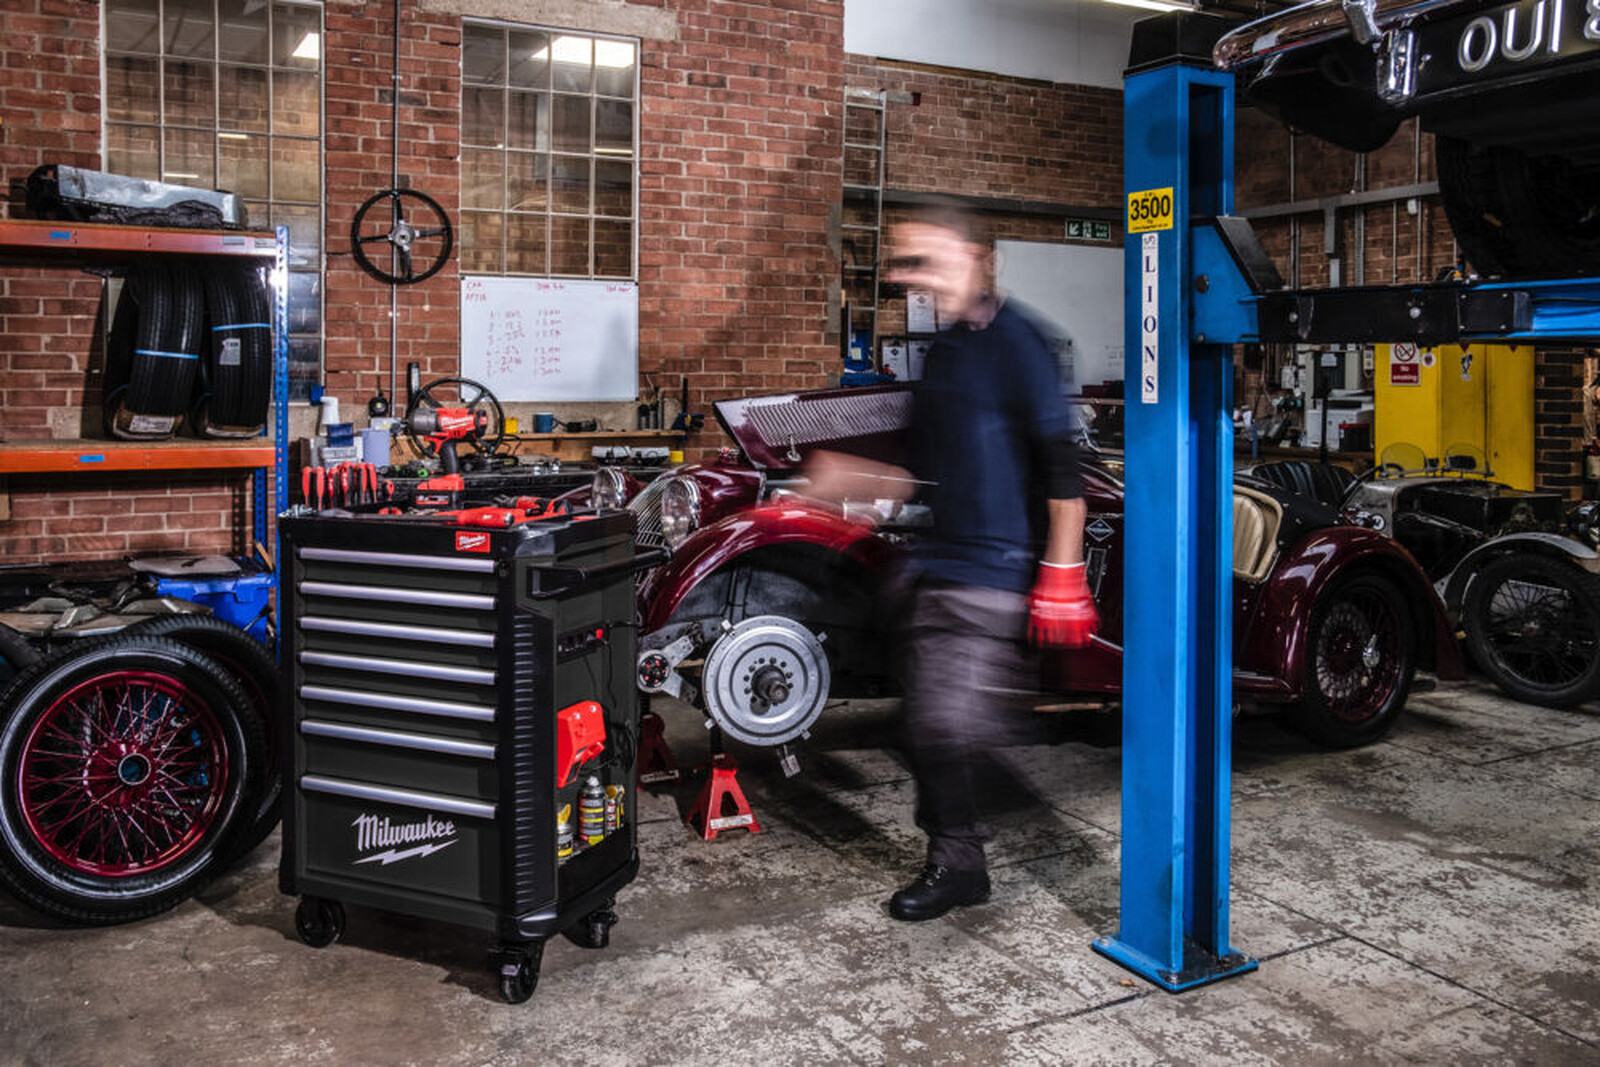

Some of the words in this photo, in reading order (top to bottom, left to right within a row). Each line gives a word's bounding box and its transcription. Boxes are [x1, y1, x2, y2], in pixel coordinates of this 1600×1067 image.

[1130, 194, 1171, 221] 3500
[1143, 255, 1157, 394] LIONS
[350, 812, 457, 852] Milwaukee
